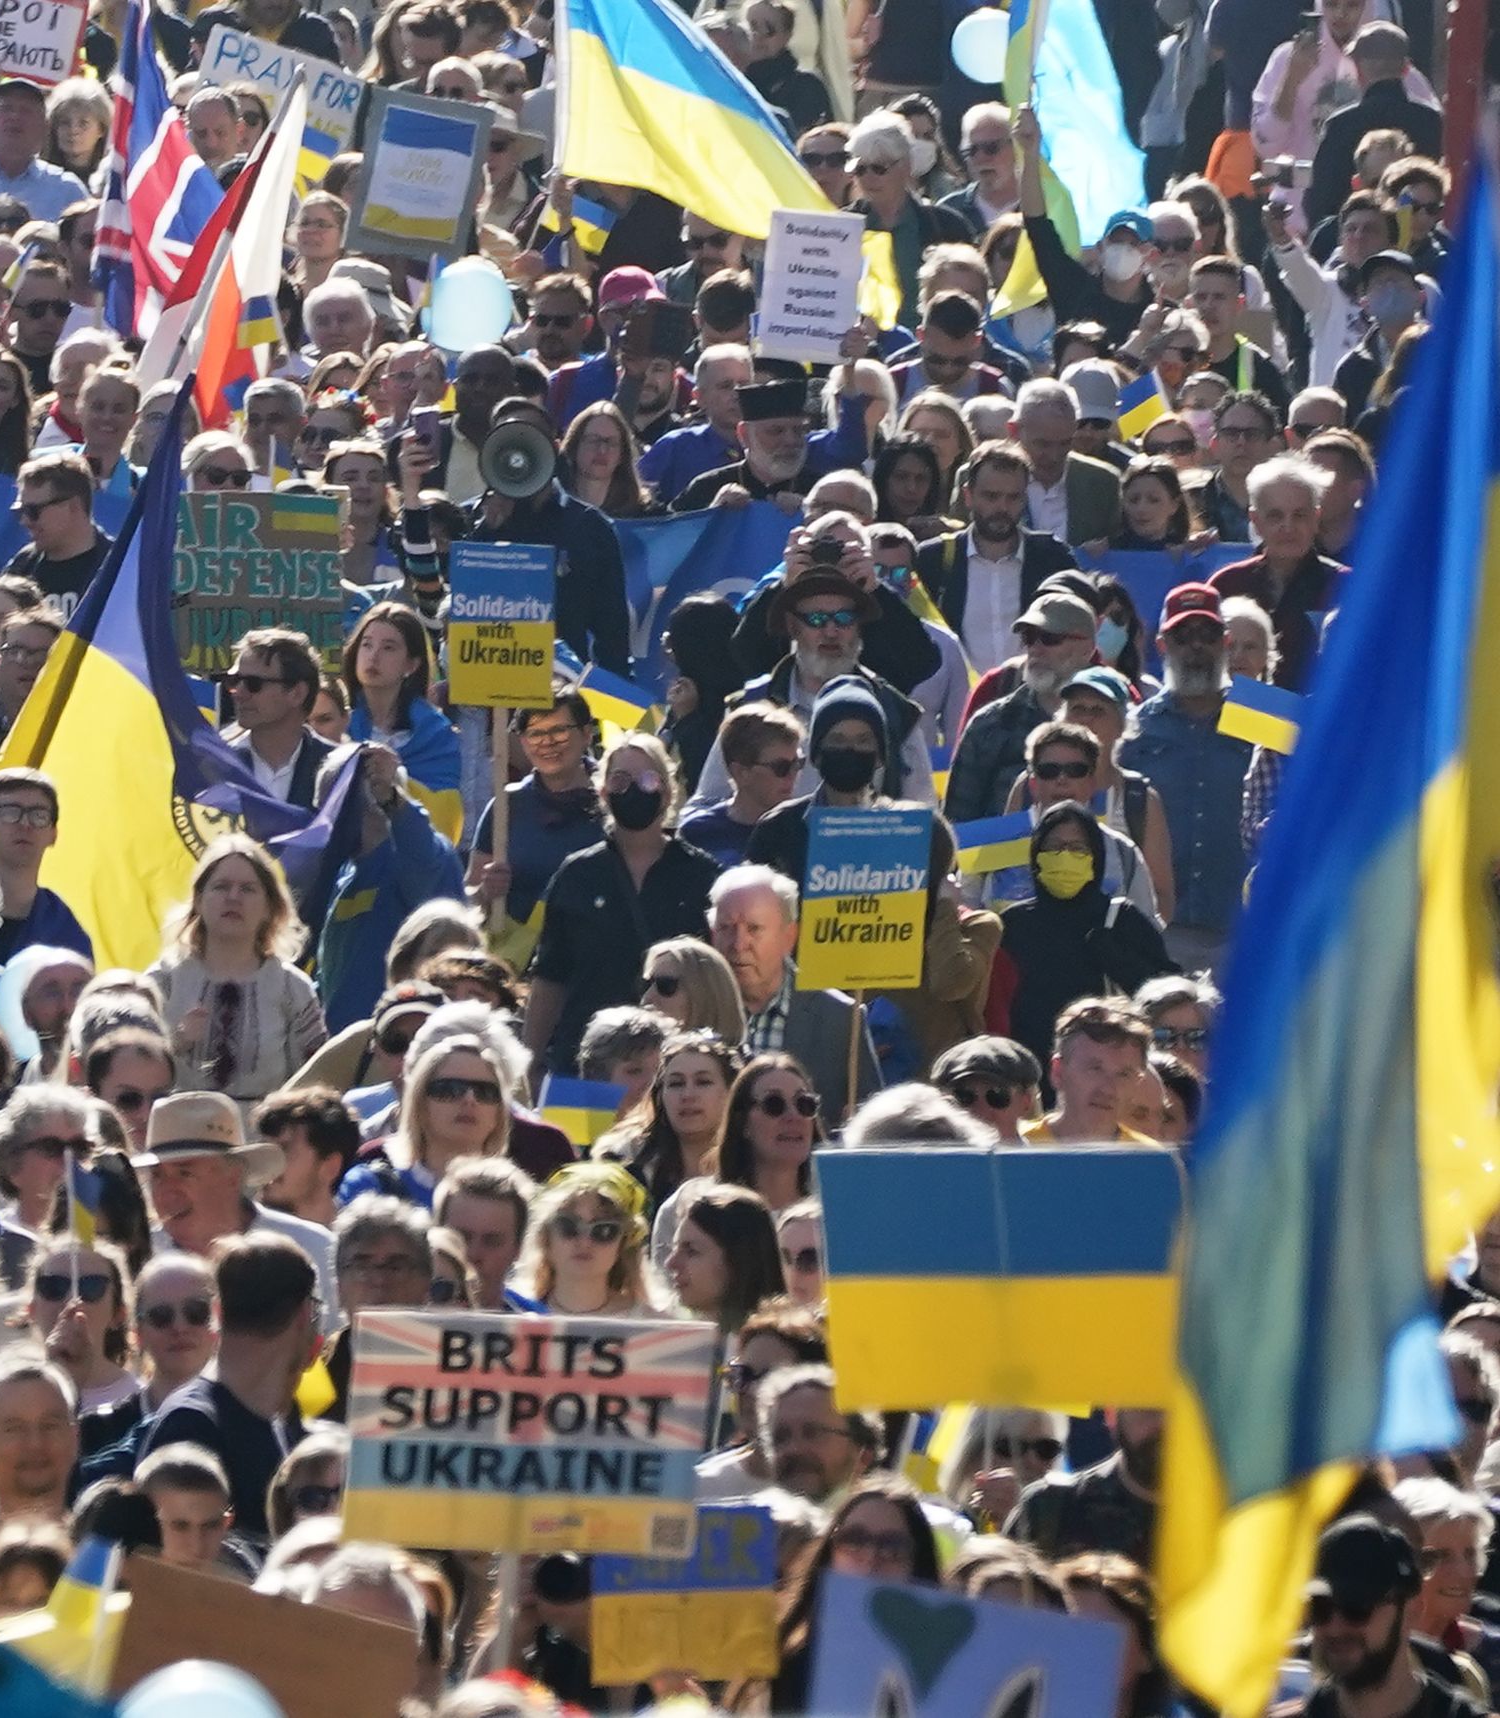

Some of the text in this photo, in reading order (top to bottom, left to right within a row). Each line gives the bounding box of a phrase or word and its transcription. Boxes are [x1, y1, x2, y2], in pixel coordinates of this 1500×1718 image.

[311, 71, 361, 113] FOR
[785, 223, 849, 242] Solidarity
[801, 247, 830, 257] with
[787, 263, 839, 278] Ukraine
[785, 286, 837, 300] against
[782, 303, 836, 318] Russian
[172, 549, 345, 601] DEFENSE
[452, 593, 553, 623] Solidarity
[476, 621, 515, 640] with
[460, 639, 546, 667] Ukraine
[808, 863, 926, 892] Solidarity
[836, 895, 881, 914] with
[814, 916, 913, 944] Ukraine
[439, 1331, 626, 1378] BRITS
[380, 1385, 673, 1438] SUPPORT
[381, 1443, 666, 1493] UKRAINE
